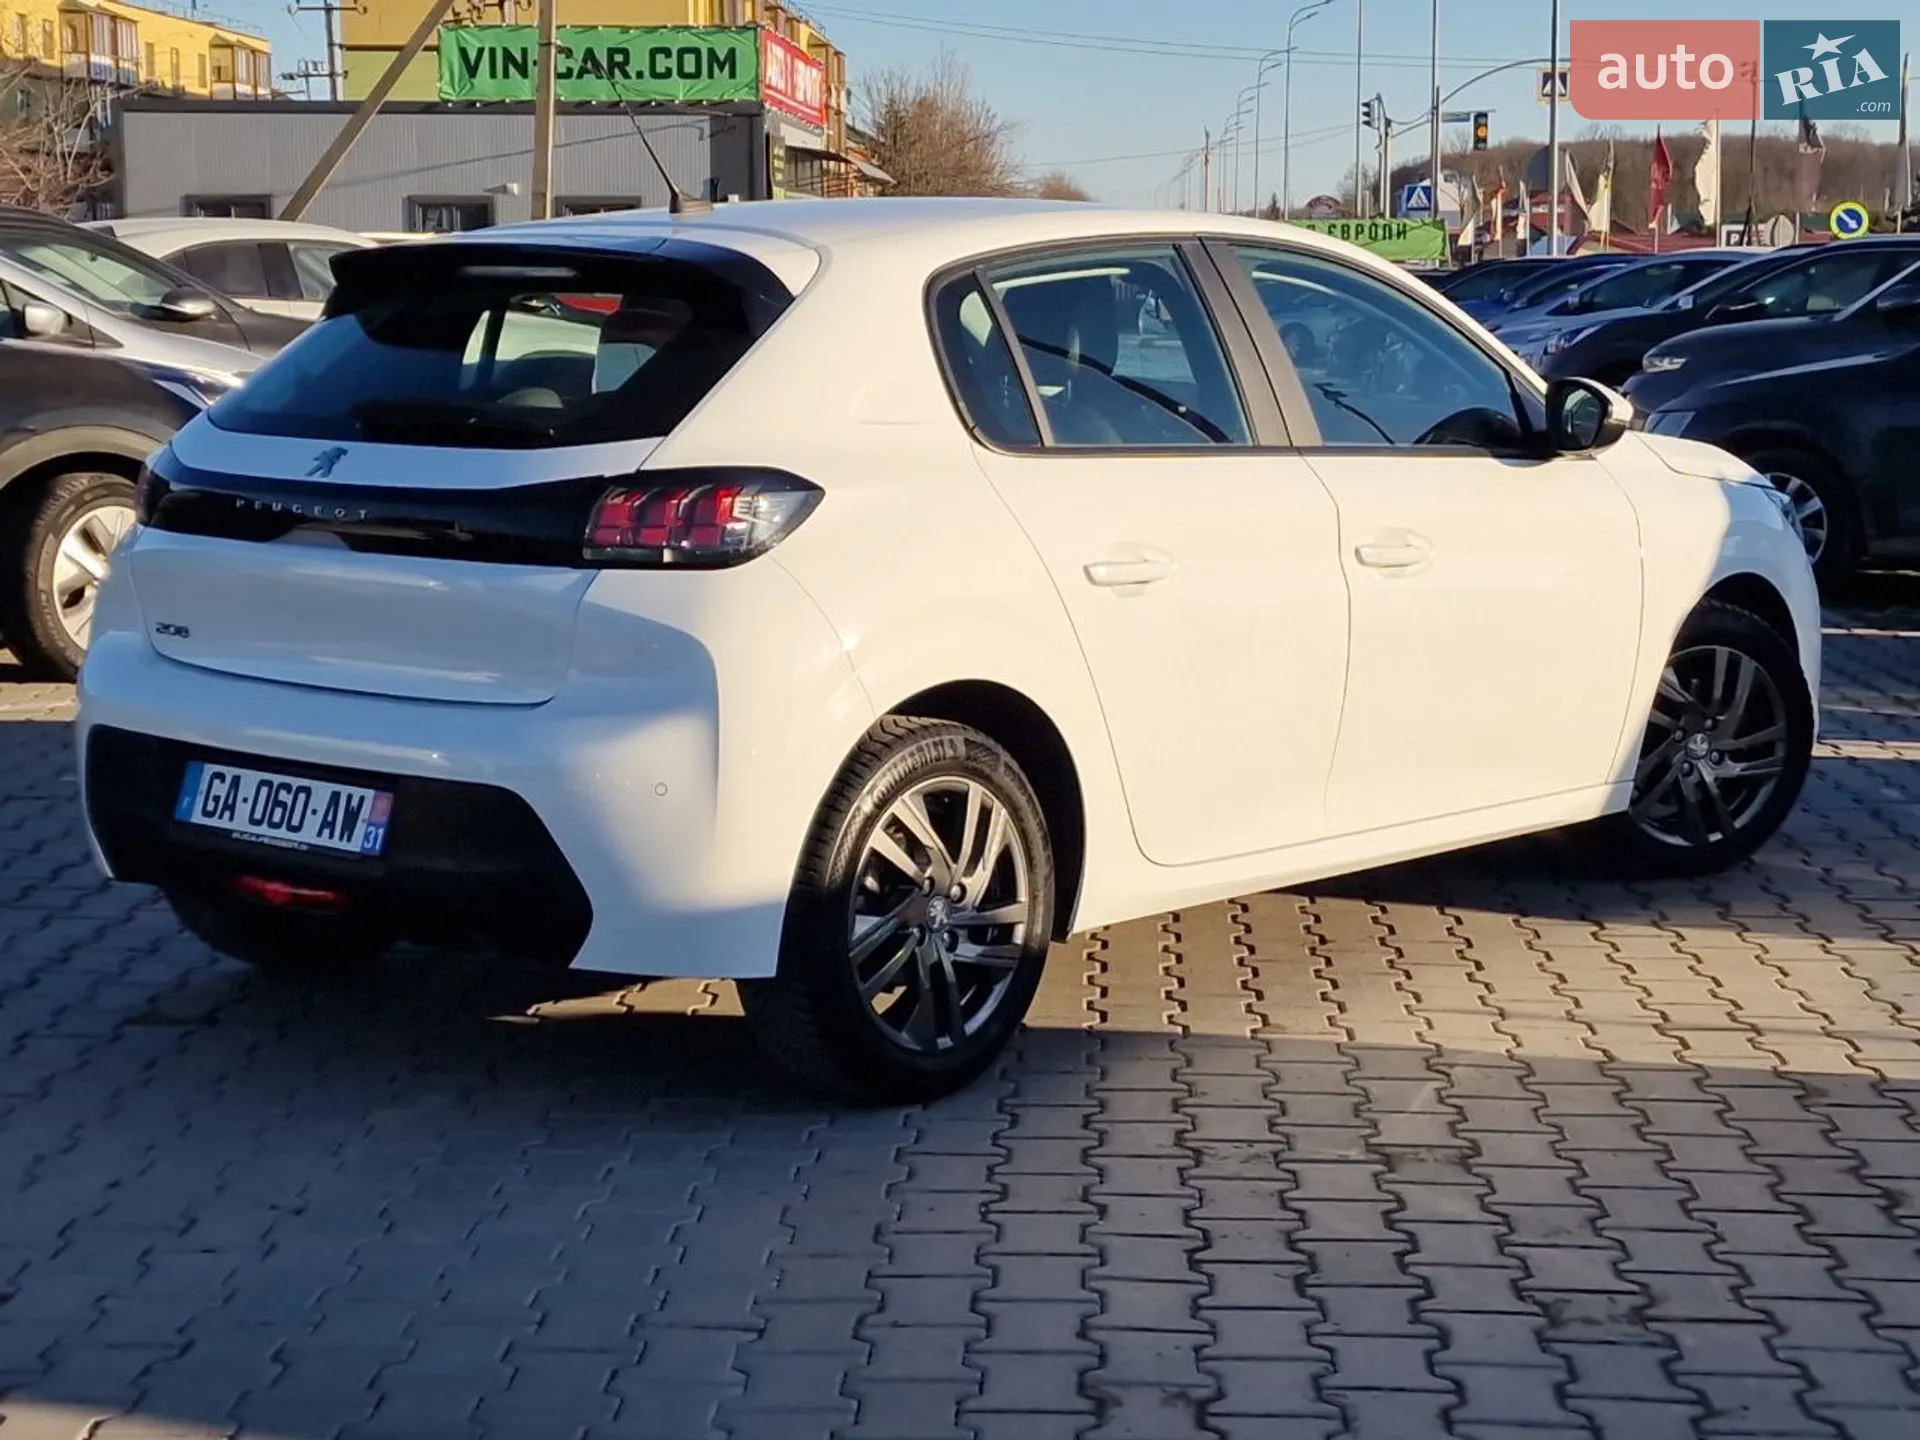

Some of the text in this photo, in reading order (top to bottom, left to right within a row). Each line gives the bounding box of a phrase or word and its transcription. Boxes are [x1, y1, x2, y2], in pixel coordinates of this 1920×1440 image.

[235, 498, 368, 519] PEUGEOT
[155, 621, 190, 639] 208
[201, 771, 366, 843] GA-060-AW
[364, 825, 386, 850] 31
